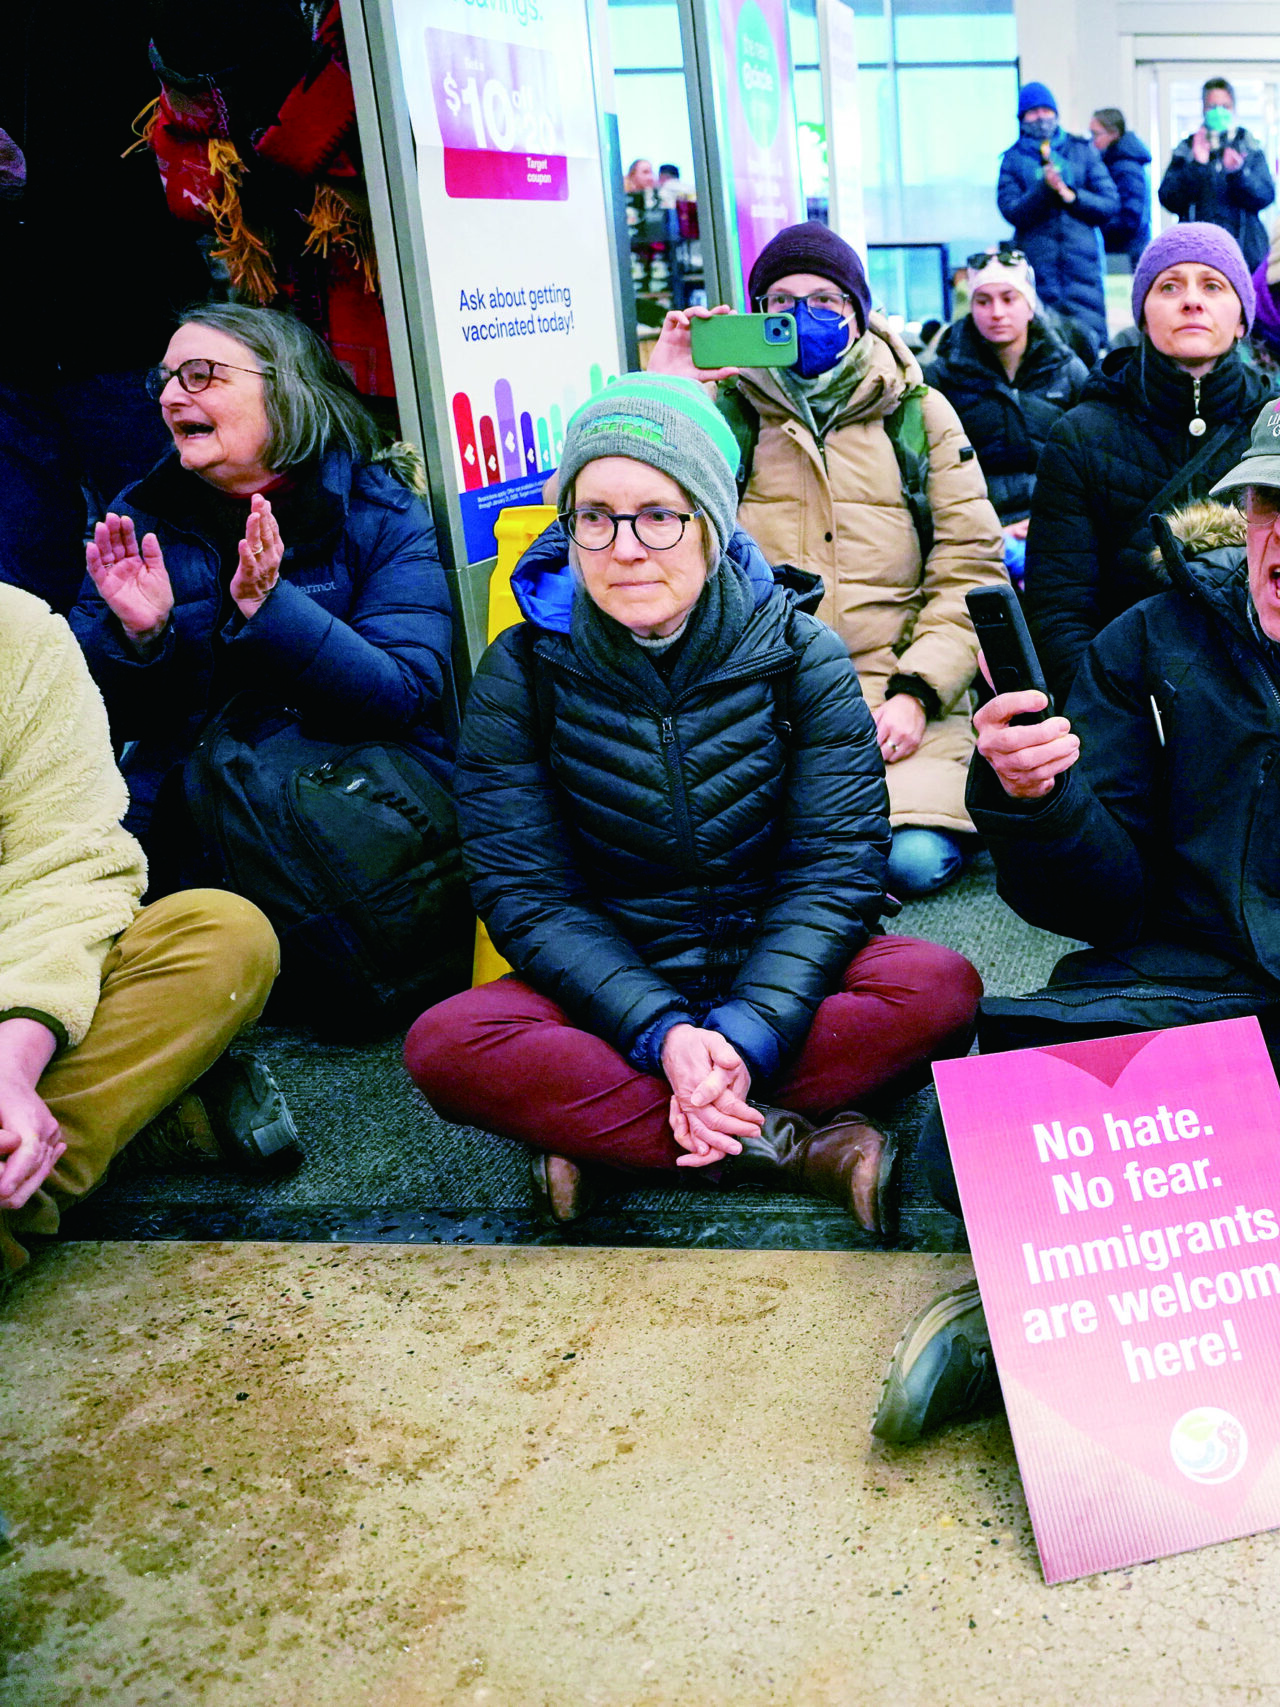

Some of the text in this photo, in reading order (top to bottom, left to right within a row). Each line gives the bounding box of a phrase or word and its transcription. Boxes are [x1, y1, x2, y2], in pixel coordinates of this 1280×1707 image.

[443, 71, 516, 152] $10
[526, 157, 548, 172] Target
[527, 173, 552, 186] coupon
[459, 283, 571, 311] Ask about getting
[462, 310, 575, 342] vaccinated today!
[296, 581, 337, 593] armot
[1033, 1105, 1214, 1163] No hate.
[1052, 1158, 1223, 1215] No fear.
[1021, 1204, 1280, 1285] Immigrants
[1022, 1299, 1098, 1344] are
[1121, 1319, 1242, 1383] here!
